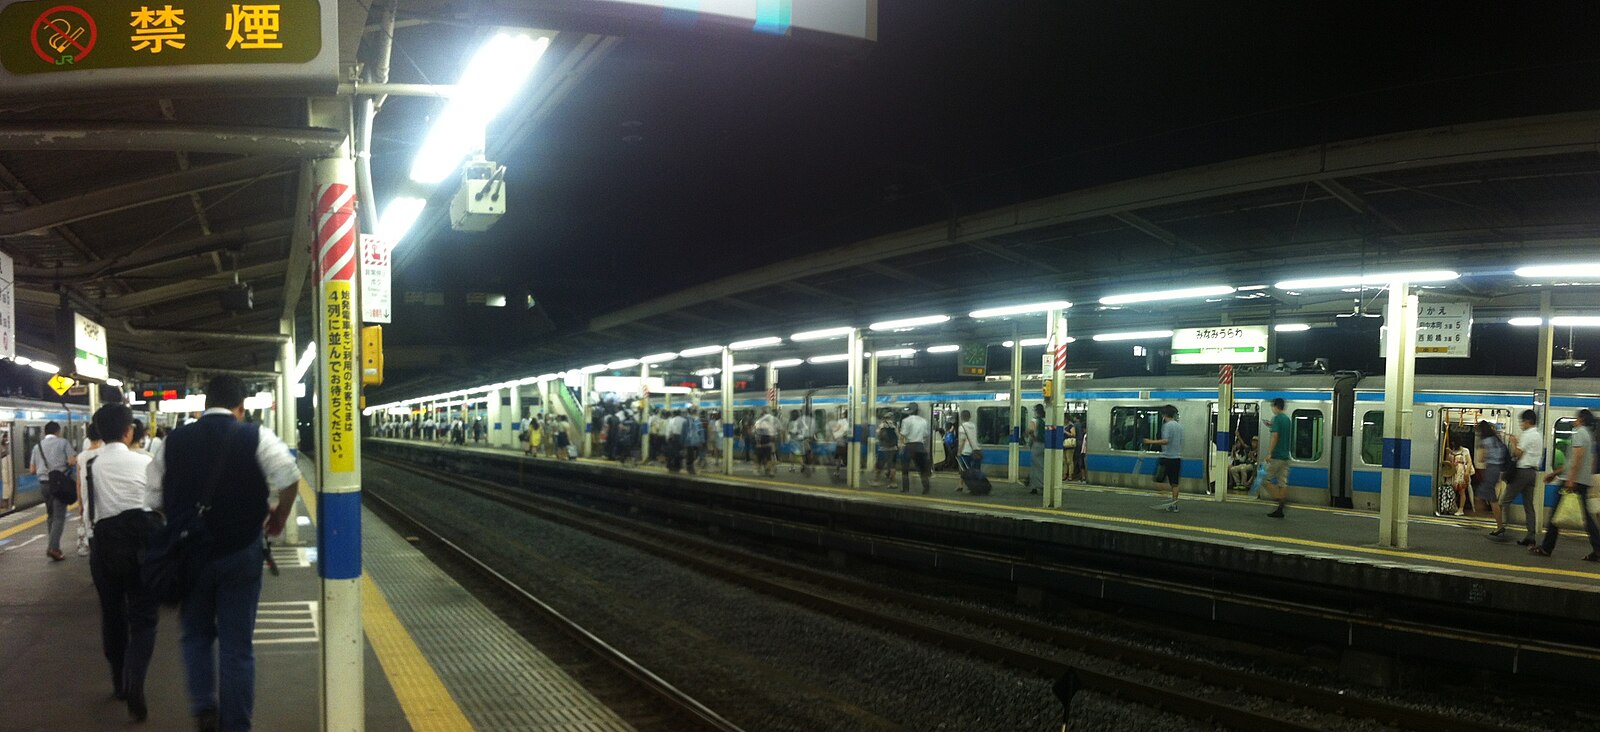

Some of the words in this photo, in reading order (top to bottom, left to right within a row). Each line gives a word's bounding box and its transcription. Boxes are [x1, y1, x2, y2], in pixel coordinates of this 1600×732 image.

[130, 4, 283, 53] 禁煙
[55, 54, 74, 65] JR
[1455, 321, 1460, 329] 5
[1196, 328, 1243, 339] みなみうらわ
[1455, 334, 1460, 342] 6
[341, 290, 353, 432] 始発電車をご利用のお客さまは
[1426, 410, 1433, 418] 6
